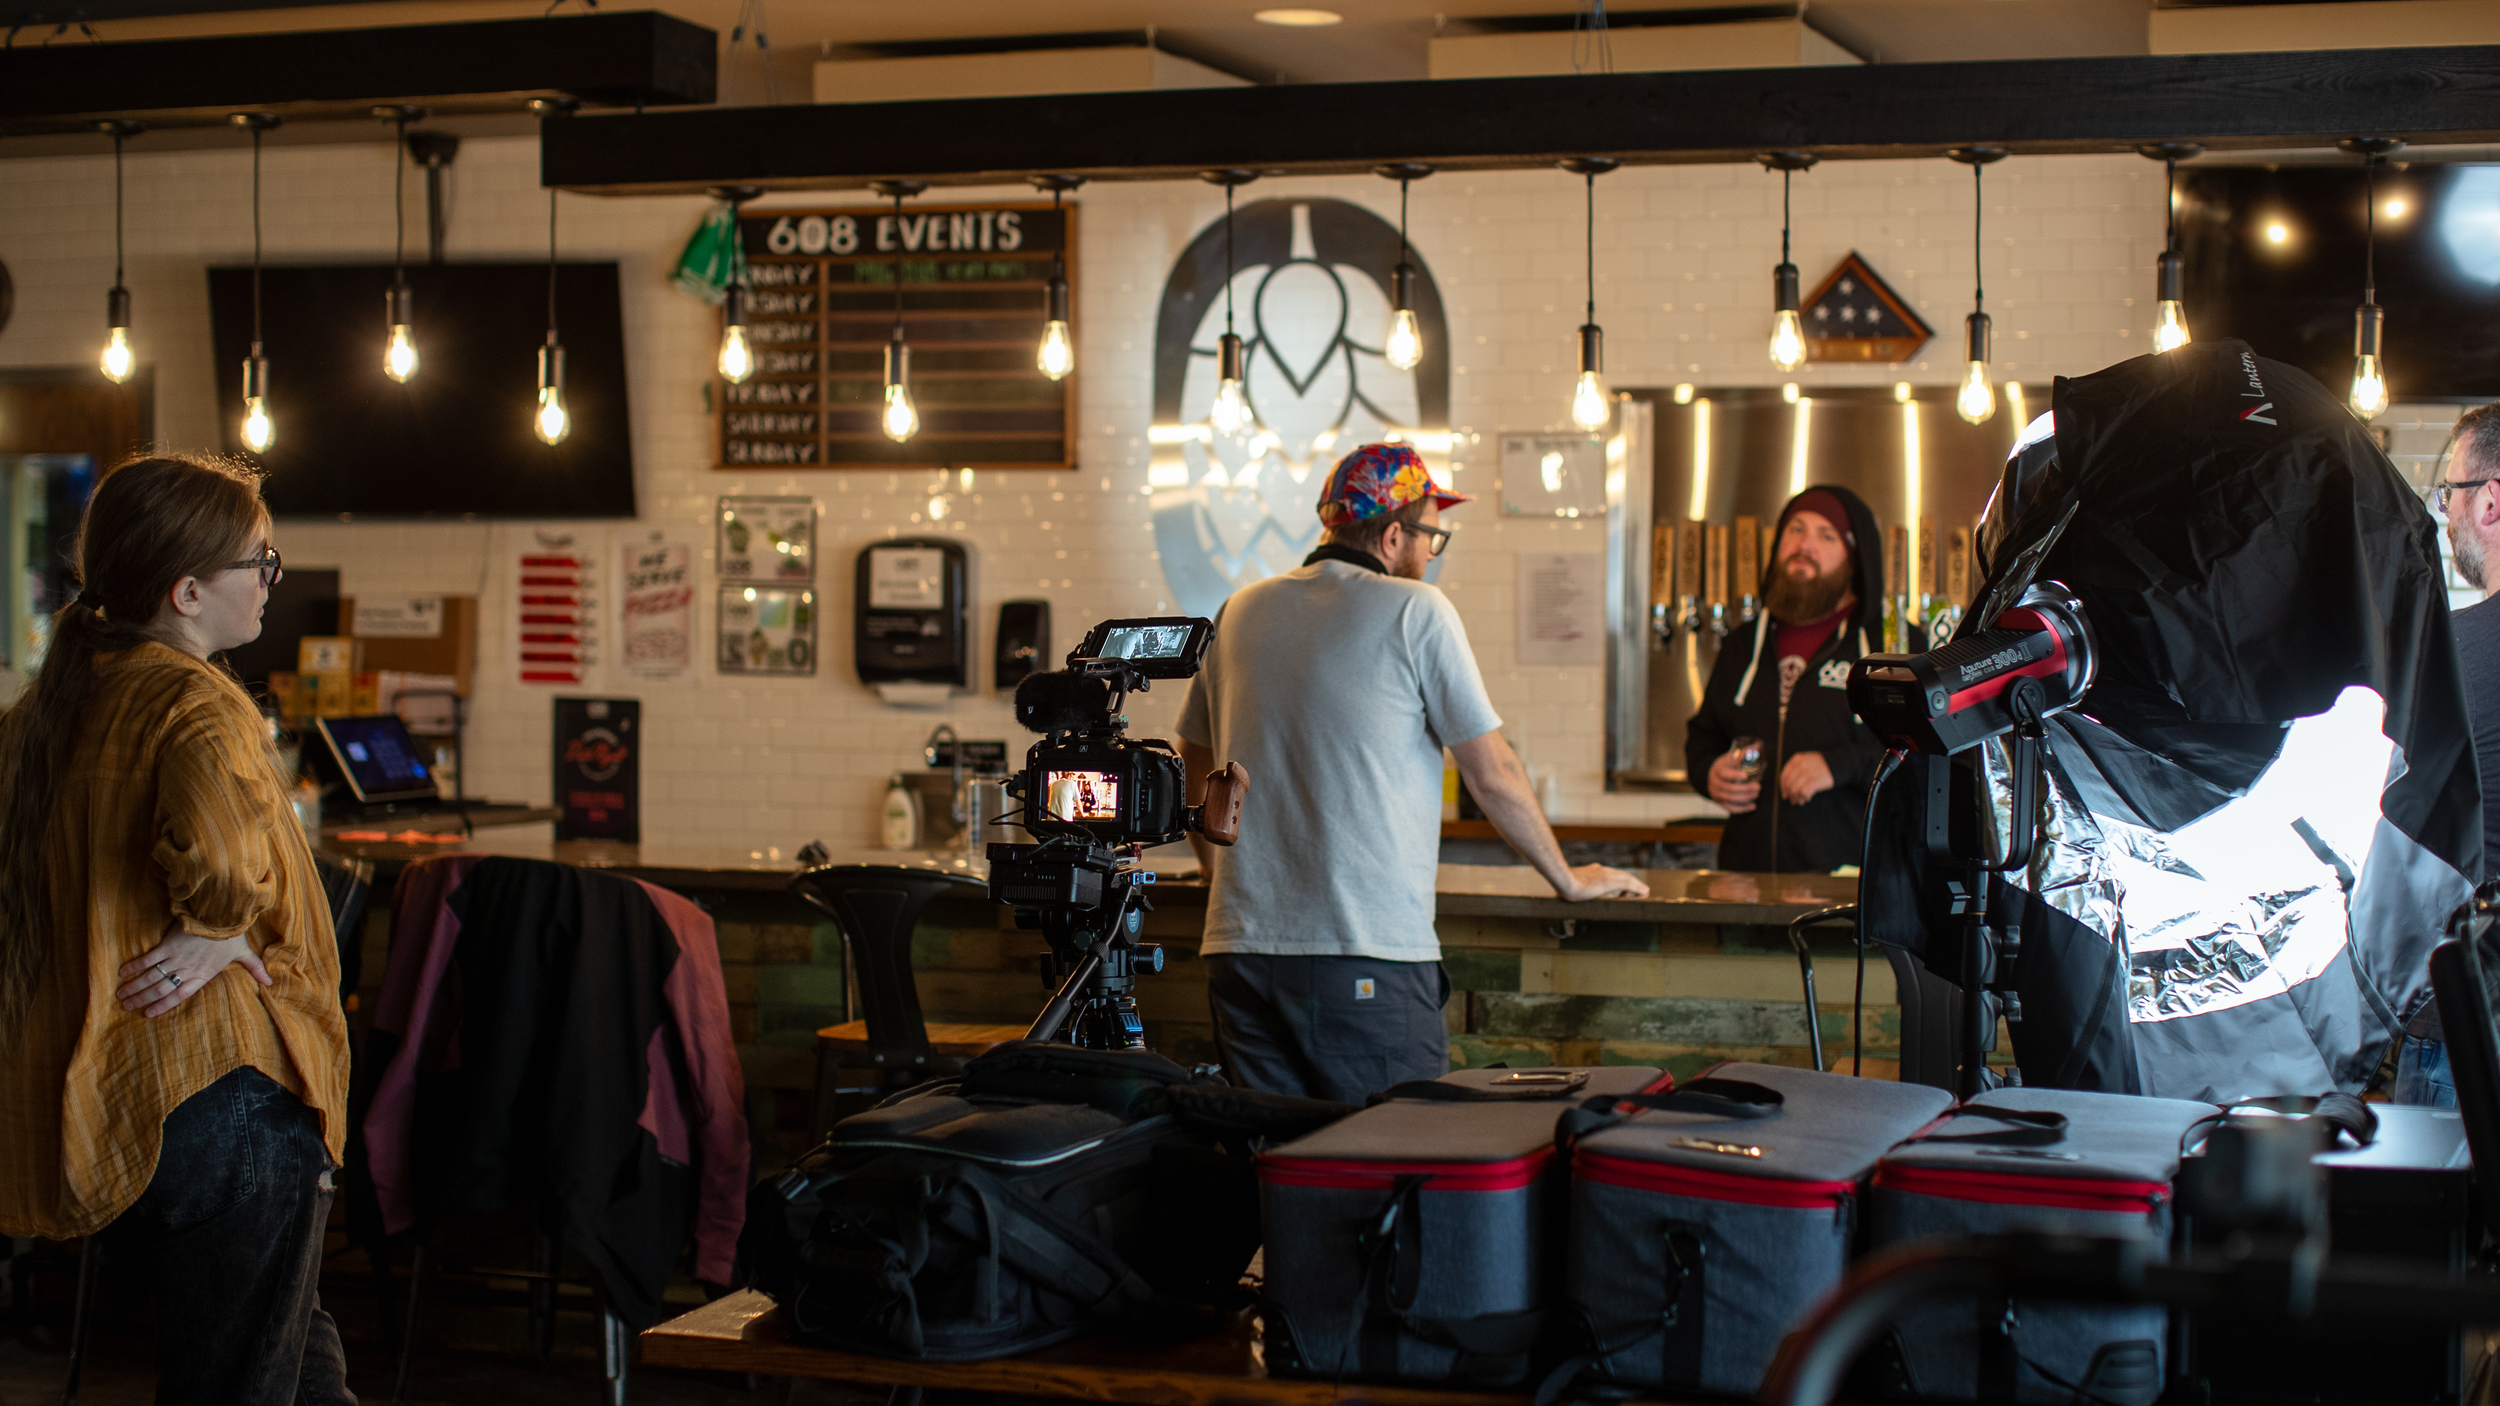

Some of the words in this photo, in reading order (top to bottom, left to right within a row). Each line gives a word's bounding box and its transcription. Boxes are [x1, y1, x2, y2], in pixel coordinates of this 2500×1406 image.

[767, 215, 860, 256] 608
[876, 211, 1023, 252] EVENTS
[2239, 351, 2265, 398] Lantern
[1818, 659, 1851, 681] 60
[1959, 657, 1993, 676] Aputure
